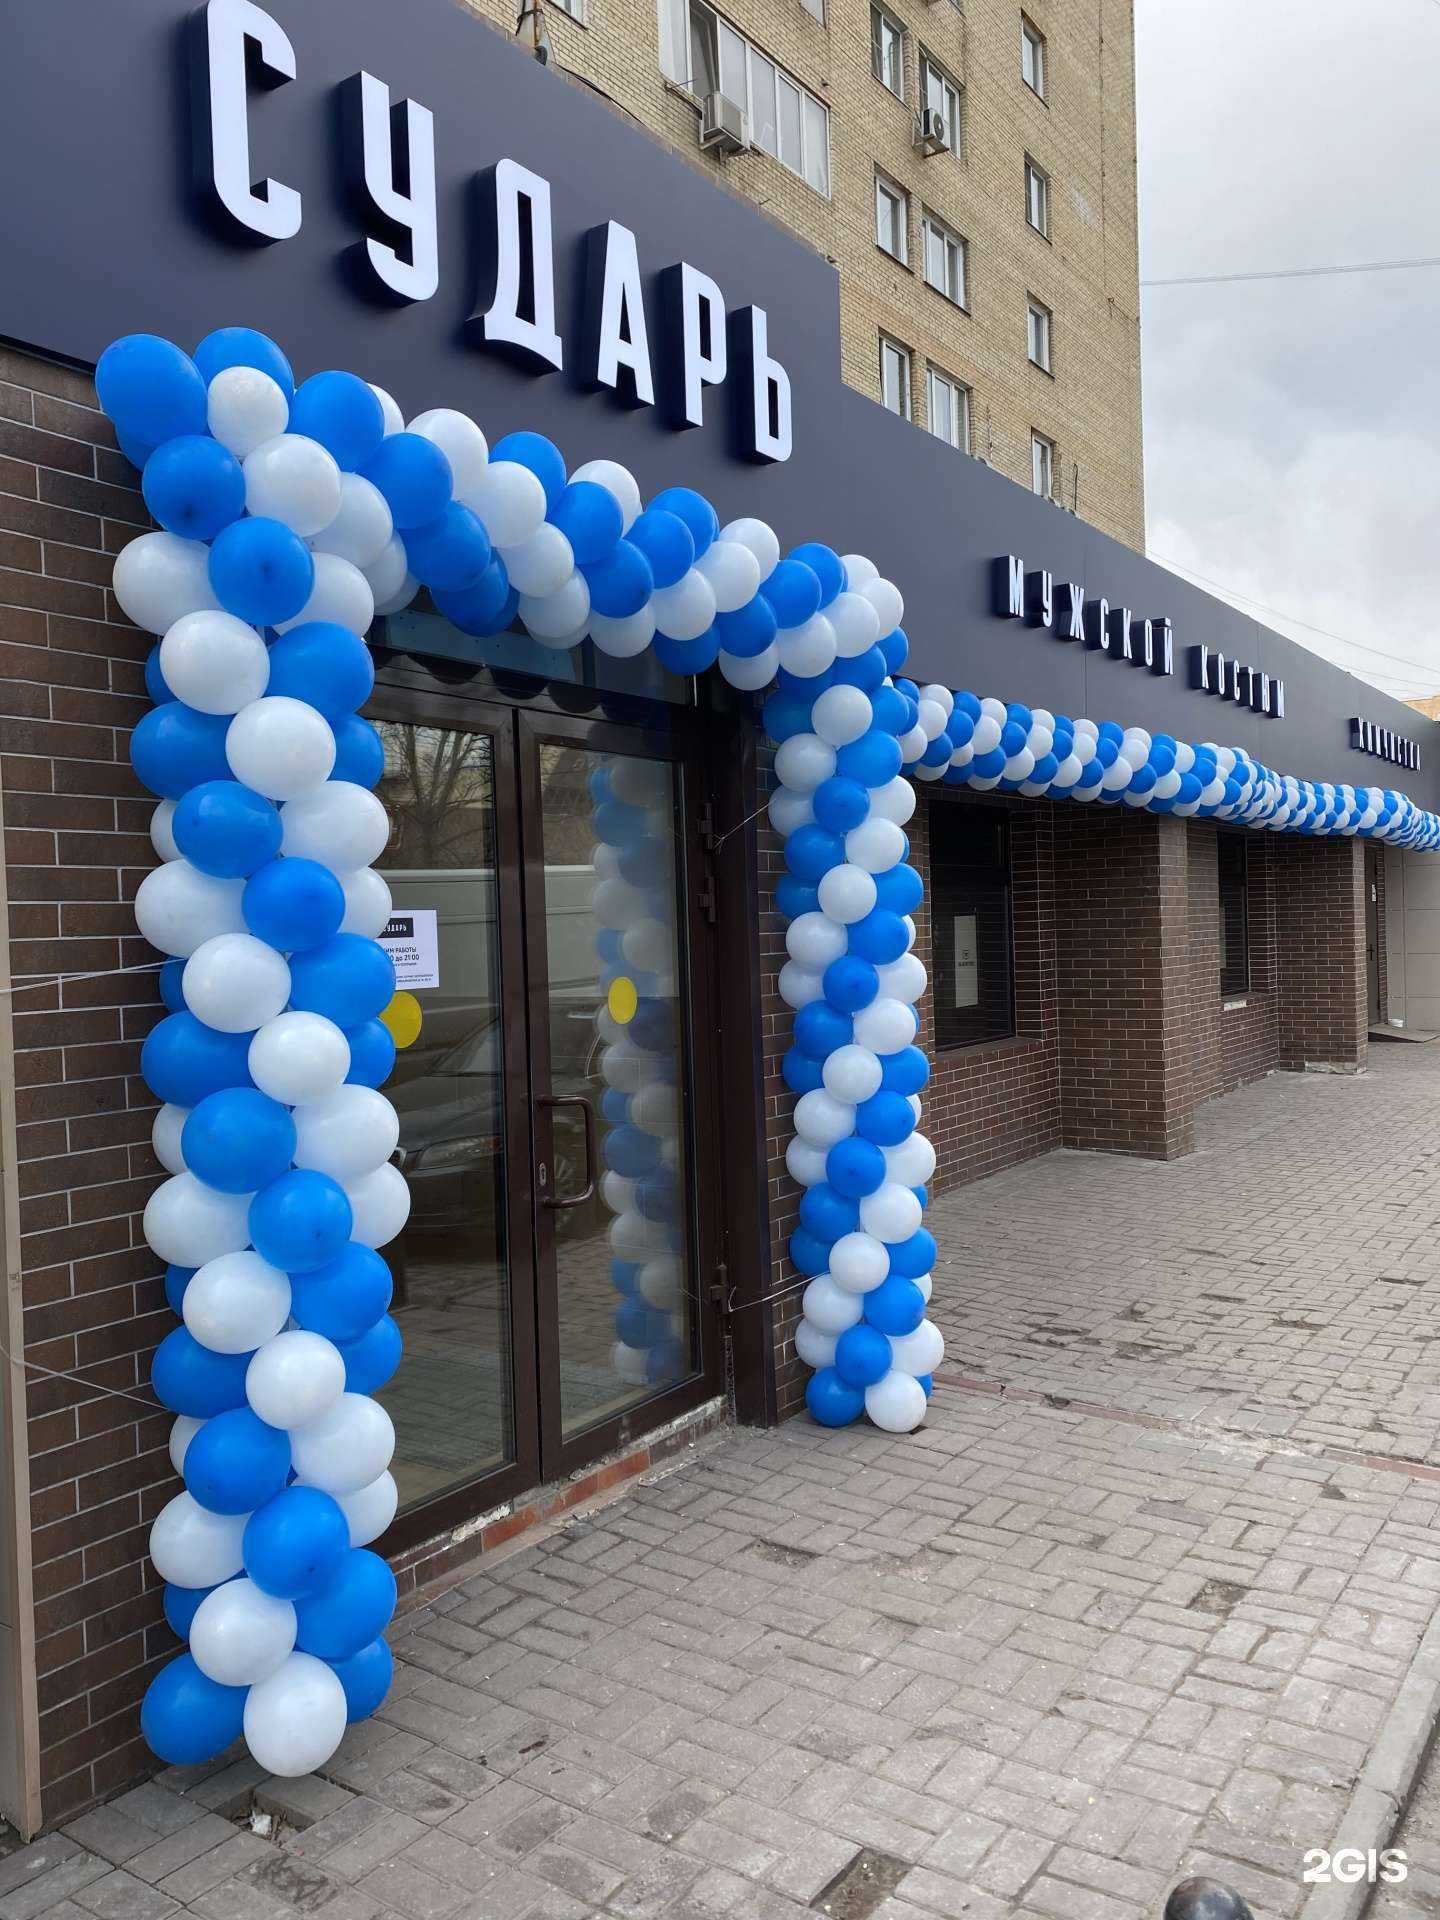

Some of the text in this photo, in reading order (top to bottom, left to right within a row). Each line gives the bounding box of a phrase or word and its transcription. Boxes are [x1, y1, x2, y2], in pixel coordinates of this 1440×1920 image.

[204, 0, 793, 463] СУДАРЬ
[1004, 554, 1286, 719] МУЖСКОЙ КОСТЮМ
